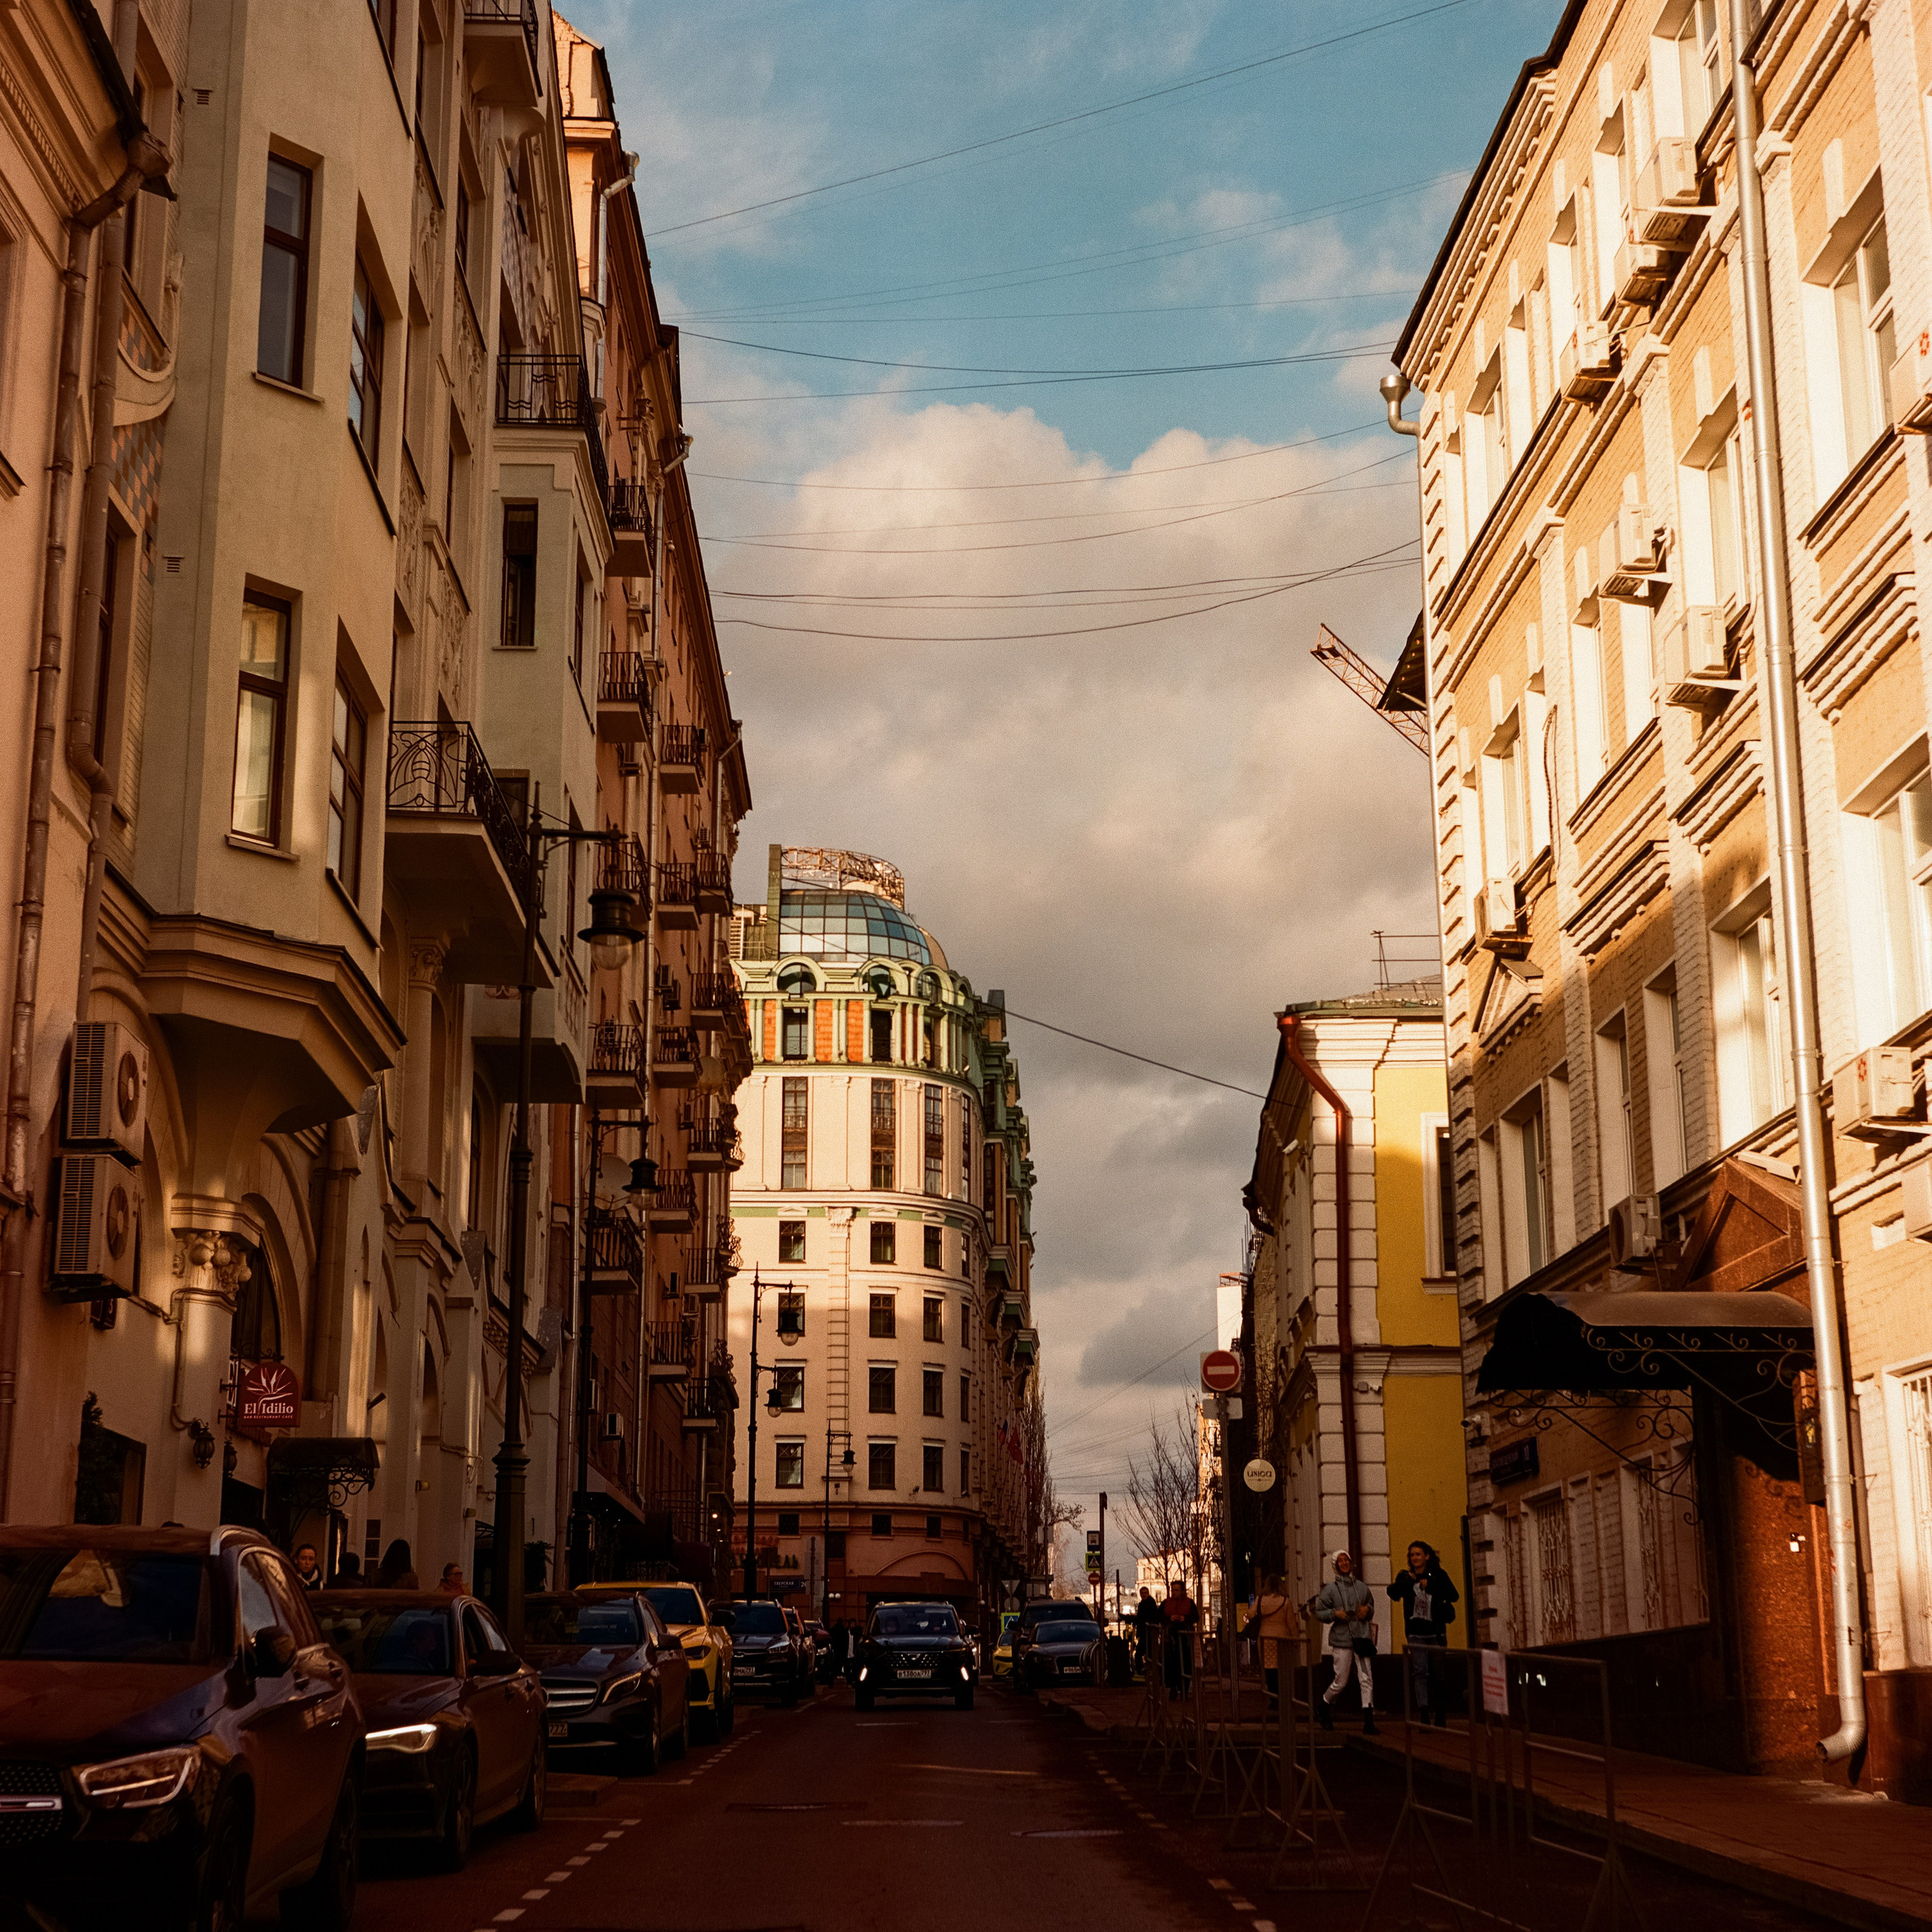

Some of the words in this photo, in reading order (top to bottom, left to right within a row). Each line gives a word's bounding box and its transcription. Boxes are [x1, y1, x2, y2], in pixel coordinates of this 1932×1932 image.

[244, 1403, 257, 1414] El
[261, 1403, 294, 1414] Idilio
[549, 1724, 565, 1734] 777
